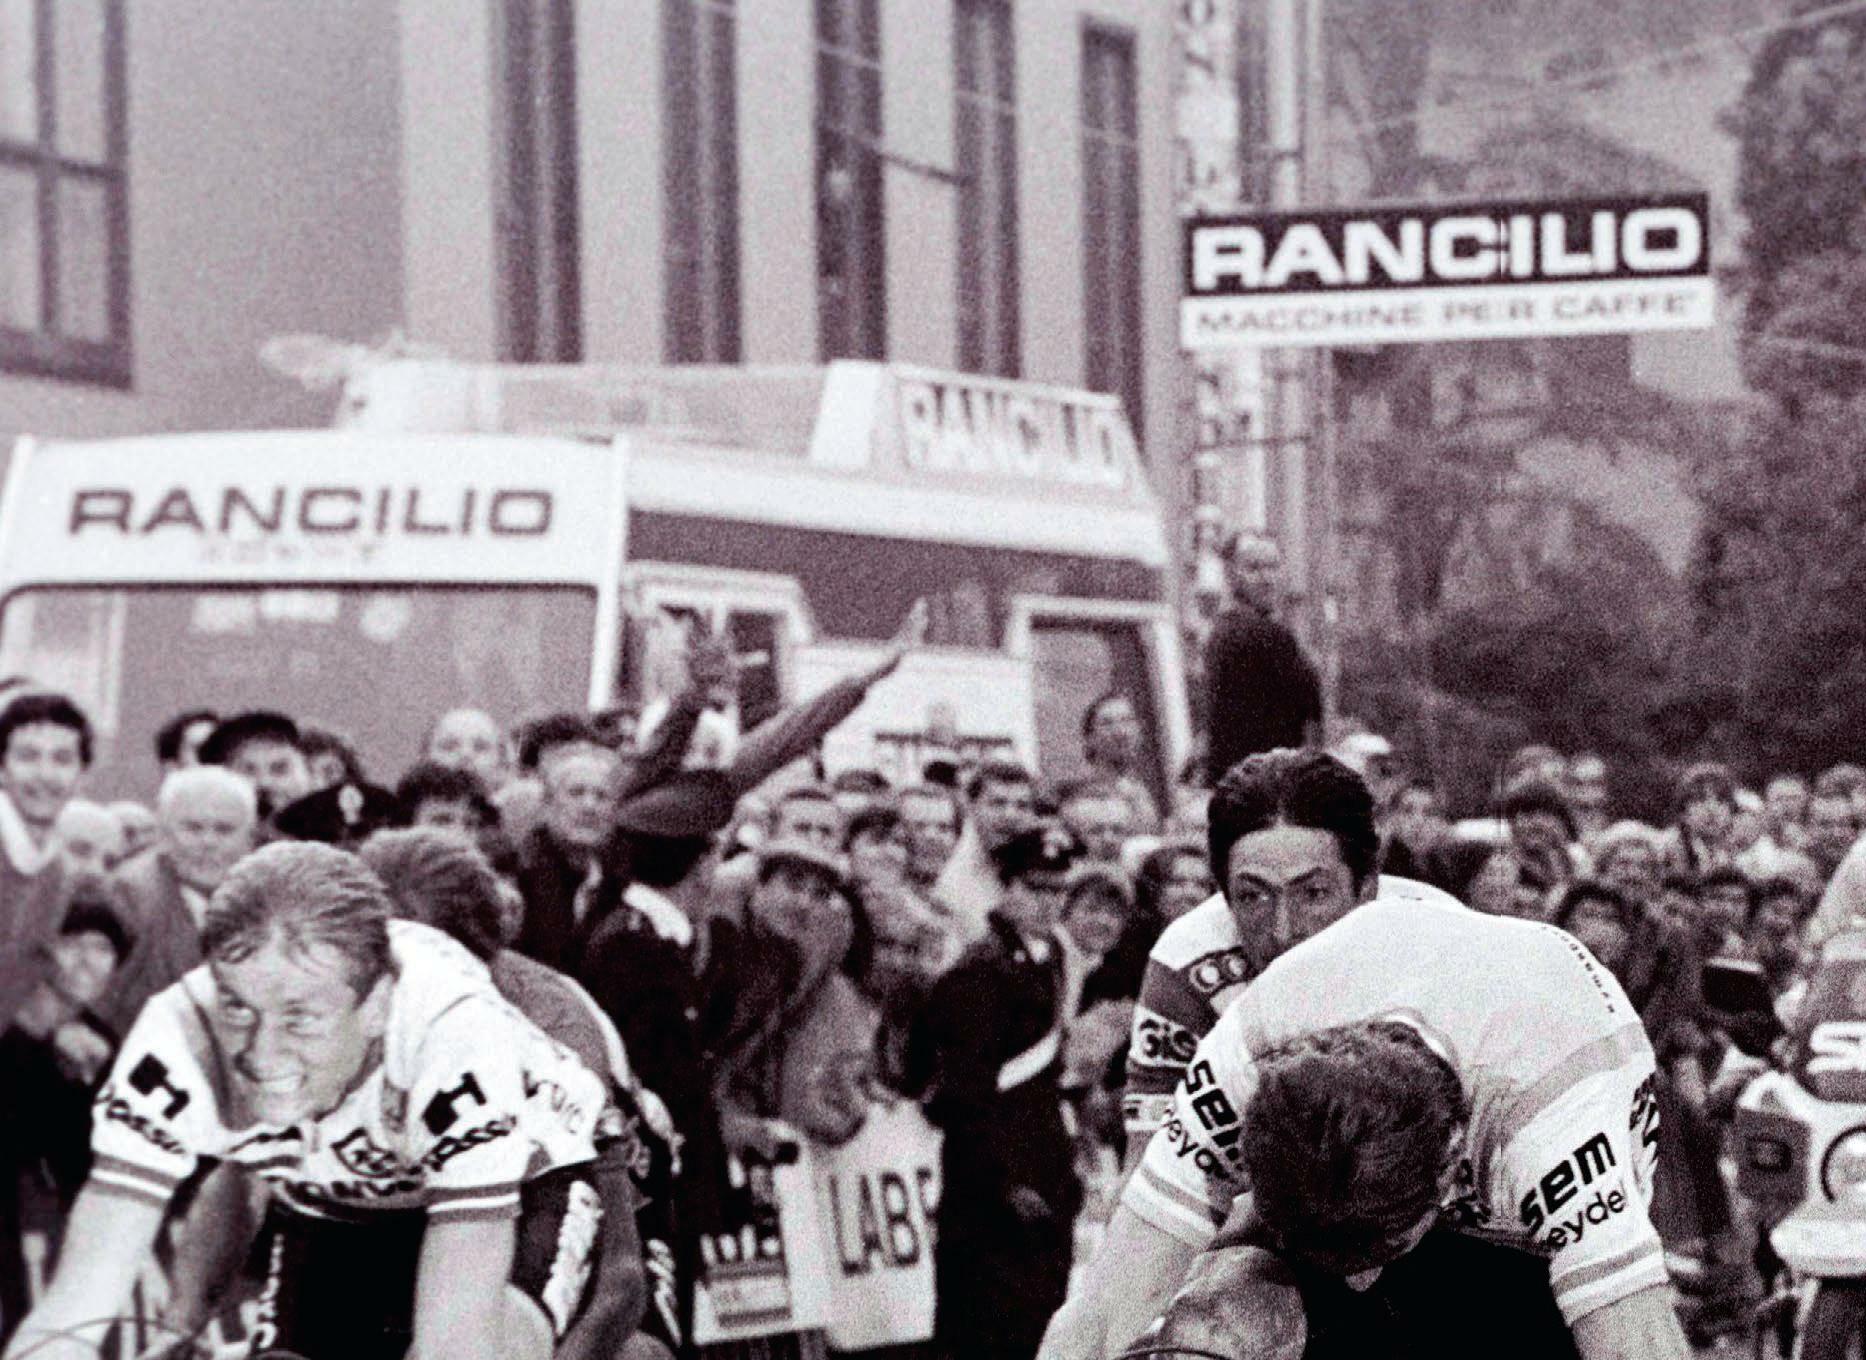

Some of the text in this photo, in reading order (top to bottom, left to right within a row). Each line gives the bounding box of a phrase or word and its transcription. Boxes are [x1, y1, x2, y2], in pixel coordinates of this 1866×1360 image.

[1192, 207, 1701, 290] RANCILIO
[1199, 299, 1423, 331] MACCHINE
[1443, 297, 1534, 323] PER
[69, 486, 553, 537] RANCILIO
